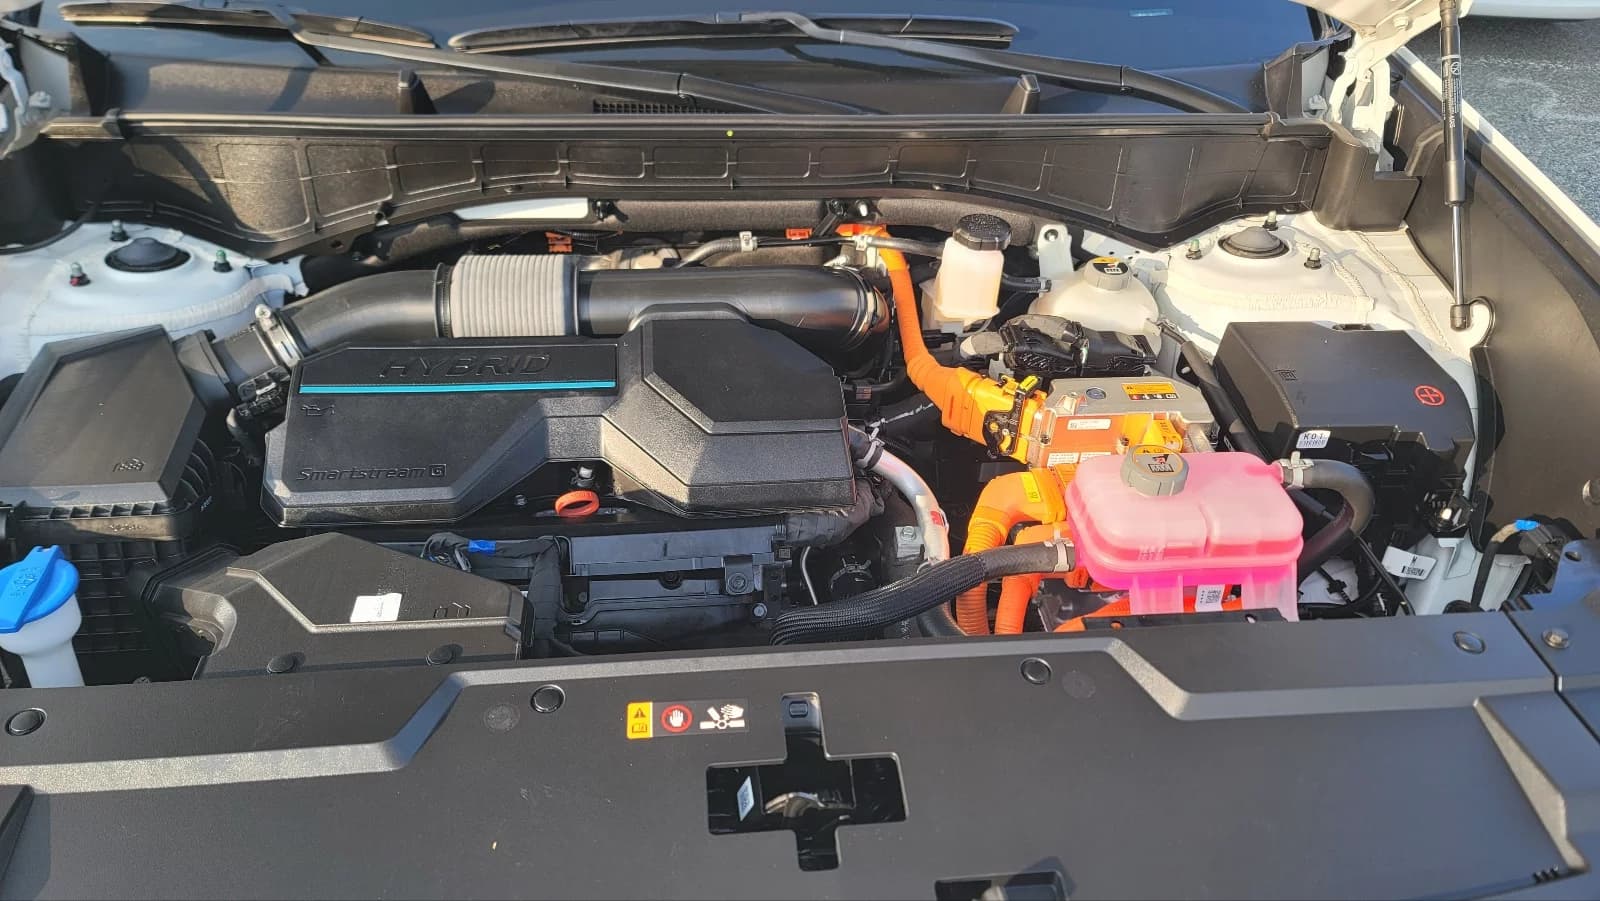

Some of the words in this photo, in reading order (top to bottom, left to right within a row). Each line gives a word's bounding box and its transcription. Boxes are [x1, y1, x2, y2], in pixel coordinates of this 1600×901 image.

[378, 353, 550, 377] HYBRID
[296, 466, 426, 481] Smartstream
[430, 463, 447, 478] G
